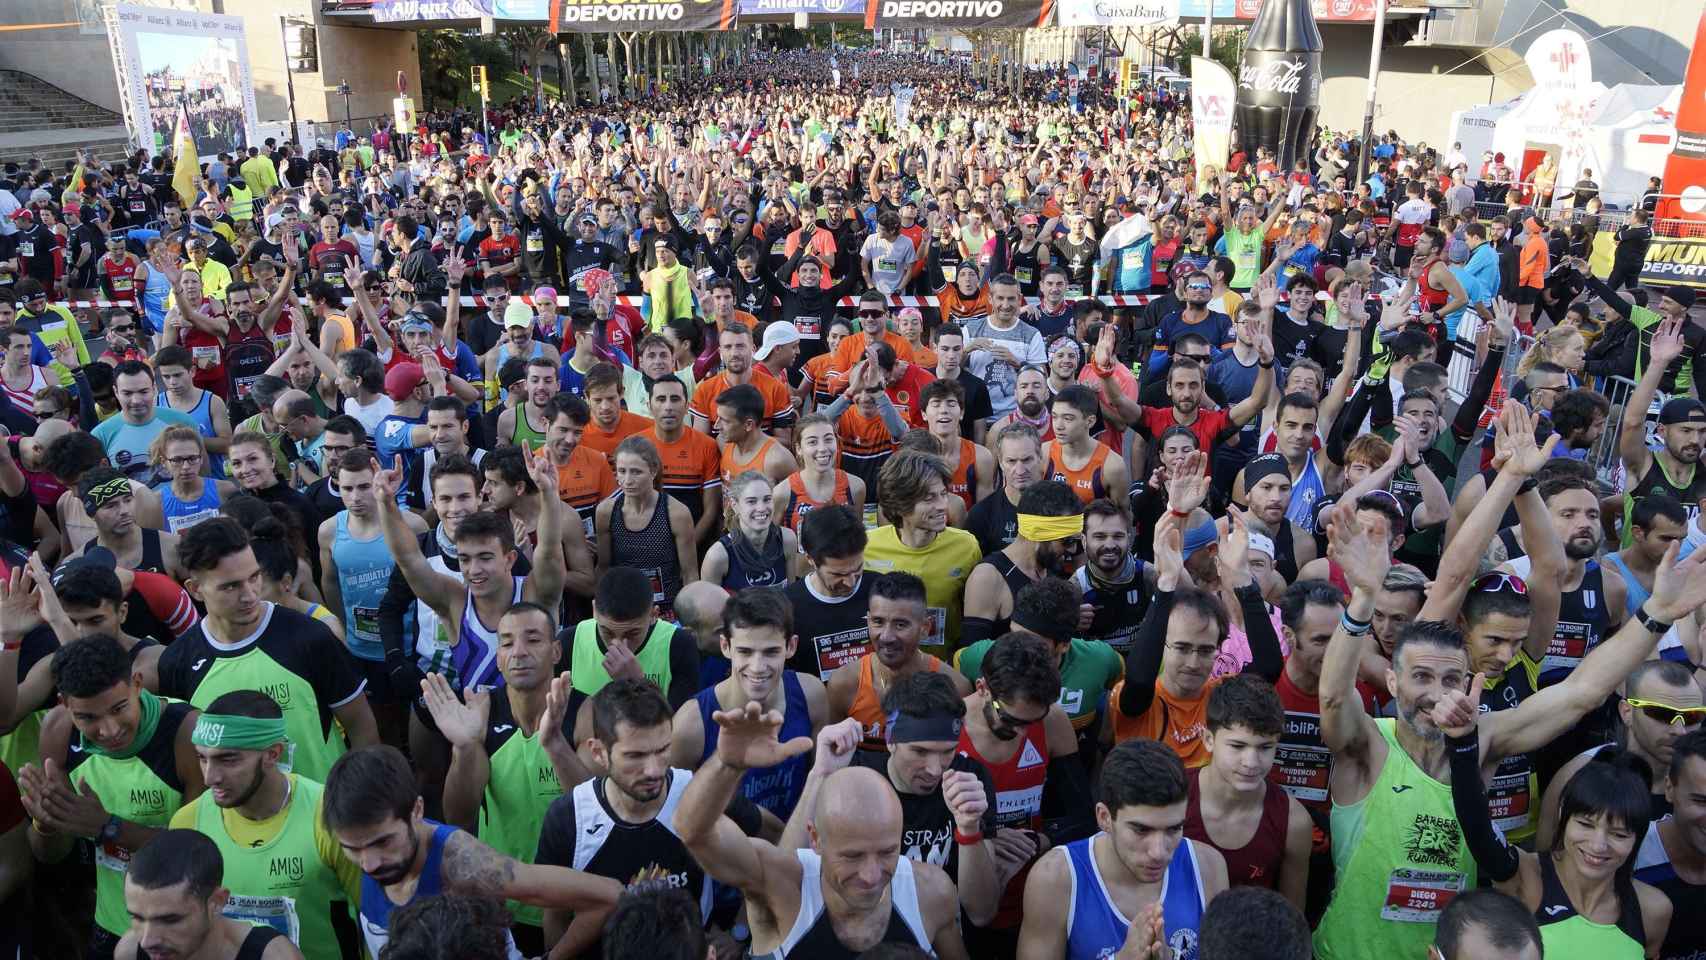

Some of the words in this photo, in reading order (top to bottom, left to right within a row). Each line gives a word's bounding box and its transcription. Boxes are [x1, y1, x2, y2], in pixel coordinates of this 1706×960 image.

[564, 4, 684, 22] DEPORTIVO
[882, 0, 1003, 18] DEPORTIVO
[1095, 2, 1168, 19] CaixaBank
[1642, 263, 1706, 278] DEPORT
[130, 788, 166, 809] AMISI
[269, 856, 304, 880] AMISI
[238, 898, 257, 906] JEAN
[1410, 889, 1438, 900] DIEGO
